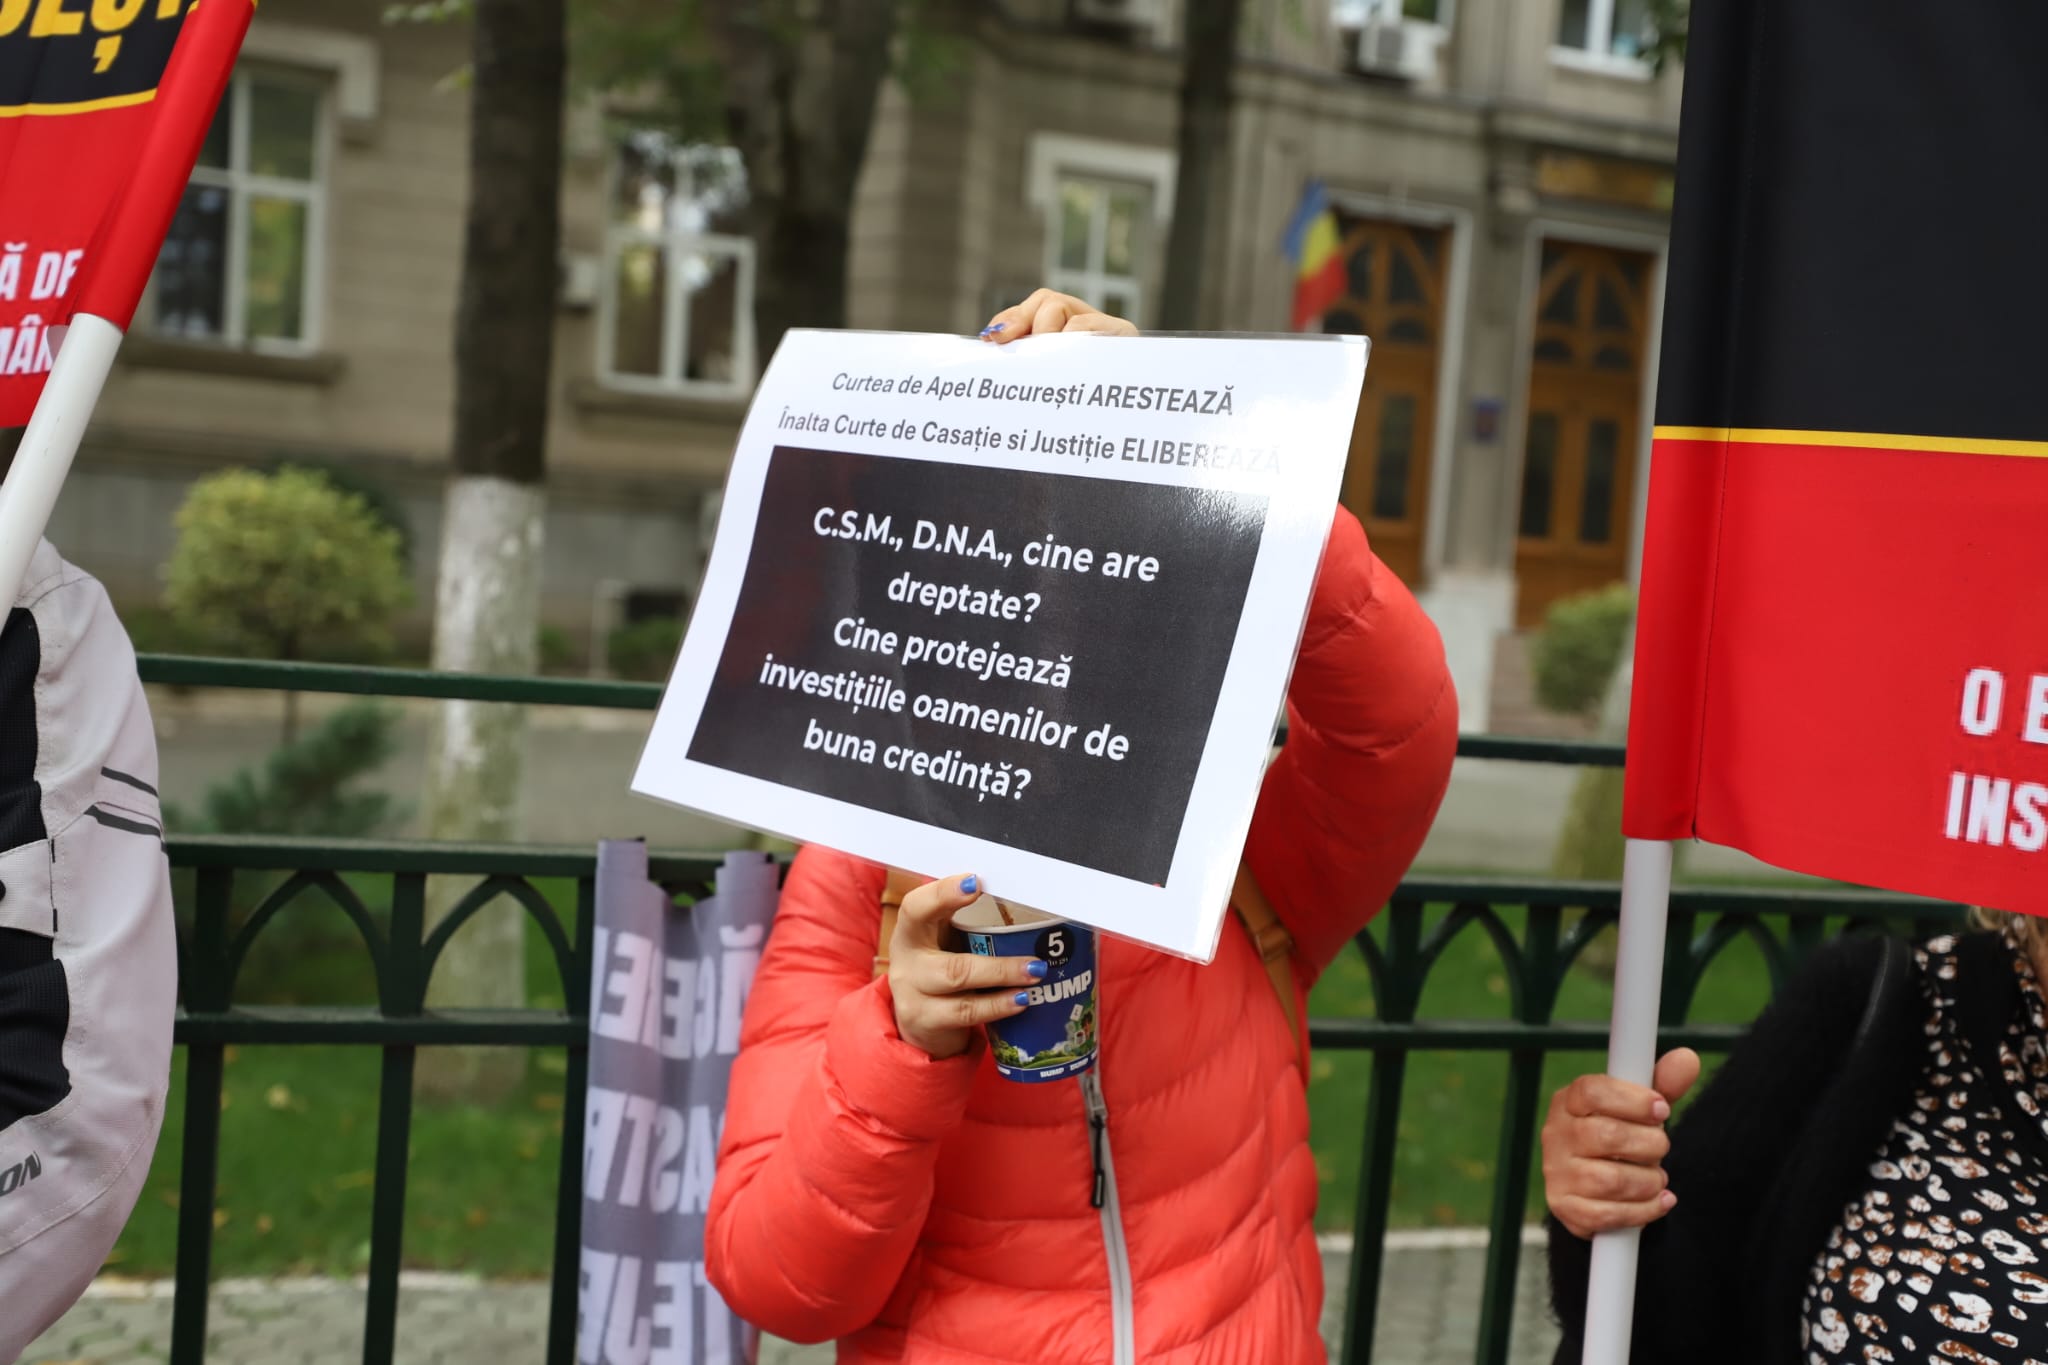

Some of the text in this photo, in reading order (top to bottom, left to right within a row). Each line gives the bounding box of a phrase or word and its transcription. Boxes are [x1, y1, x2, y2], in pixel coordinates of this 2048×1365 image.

[831, 372, 1235, 416] Curtea de Apel București ARESTEAZĂ
[777, 405, 830, 433] Înalta
[834, 414, 887, 438] Curte
[891, 419, 917, 441] de
[921, 420, 1002, 453] Casație
[1006, 428, 1028, 452] si
[1030, 429, 1115, 464] Justiție
[813, 507, 1160, 582] C.S.M., D.N.A., cine are
[887, 571, 1042, 623] dreptate?
[833, 617, 1074, 689] Cine protejează
[759, 653, 1130, 761] investițiile oamenilor de
[803, 718, 1032, 803] buna credință?
[1944, 771, 2048, 852] INS
[1047, 931, 1065, 957] 5
[1027, 969, 1092, 1006] BUMP
